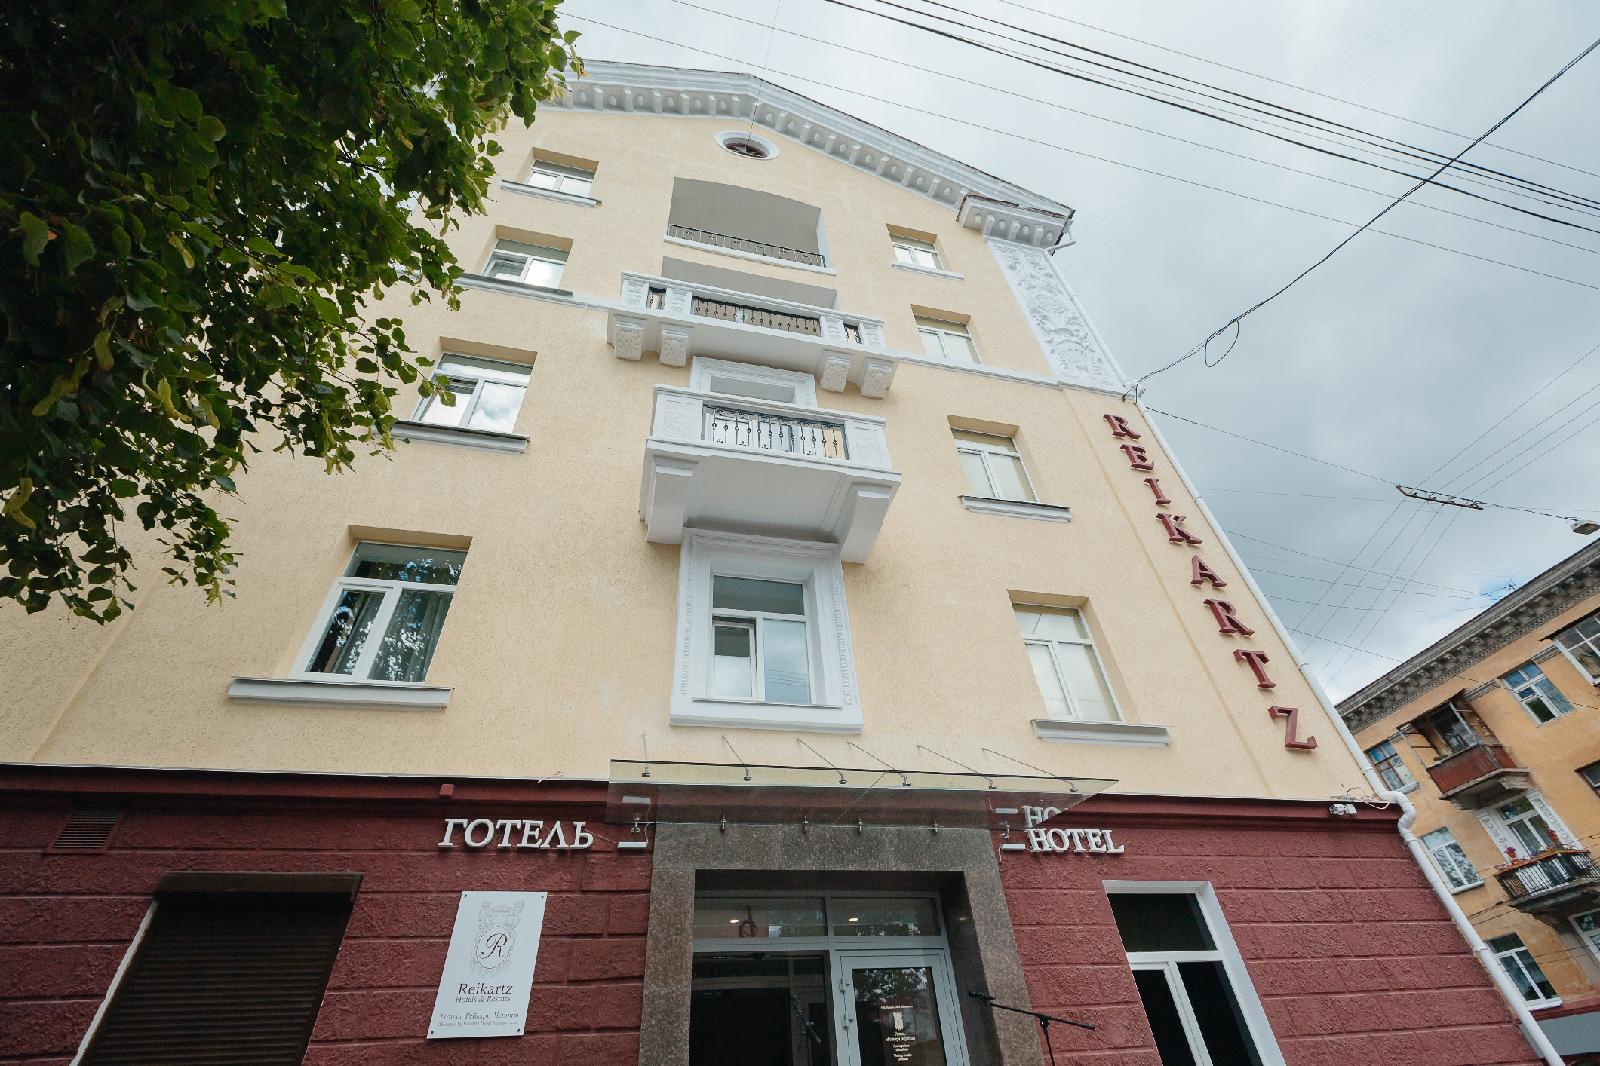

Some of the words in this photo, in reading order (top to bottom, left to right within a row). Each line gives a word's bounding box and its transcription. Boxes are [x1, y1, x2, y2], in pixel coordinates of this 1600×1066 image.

[1103, 414, 1318, 750] REIKARTZ
[438, 818, 594, 849] ГОТЕЛЬ
[1024, 828, 1125, 854] HOTEL
[458, 982, 514, 995] Reikartz
